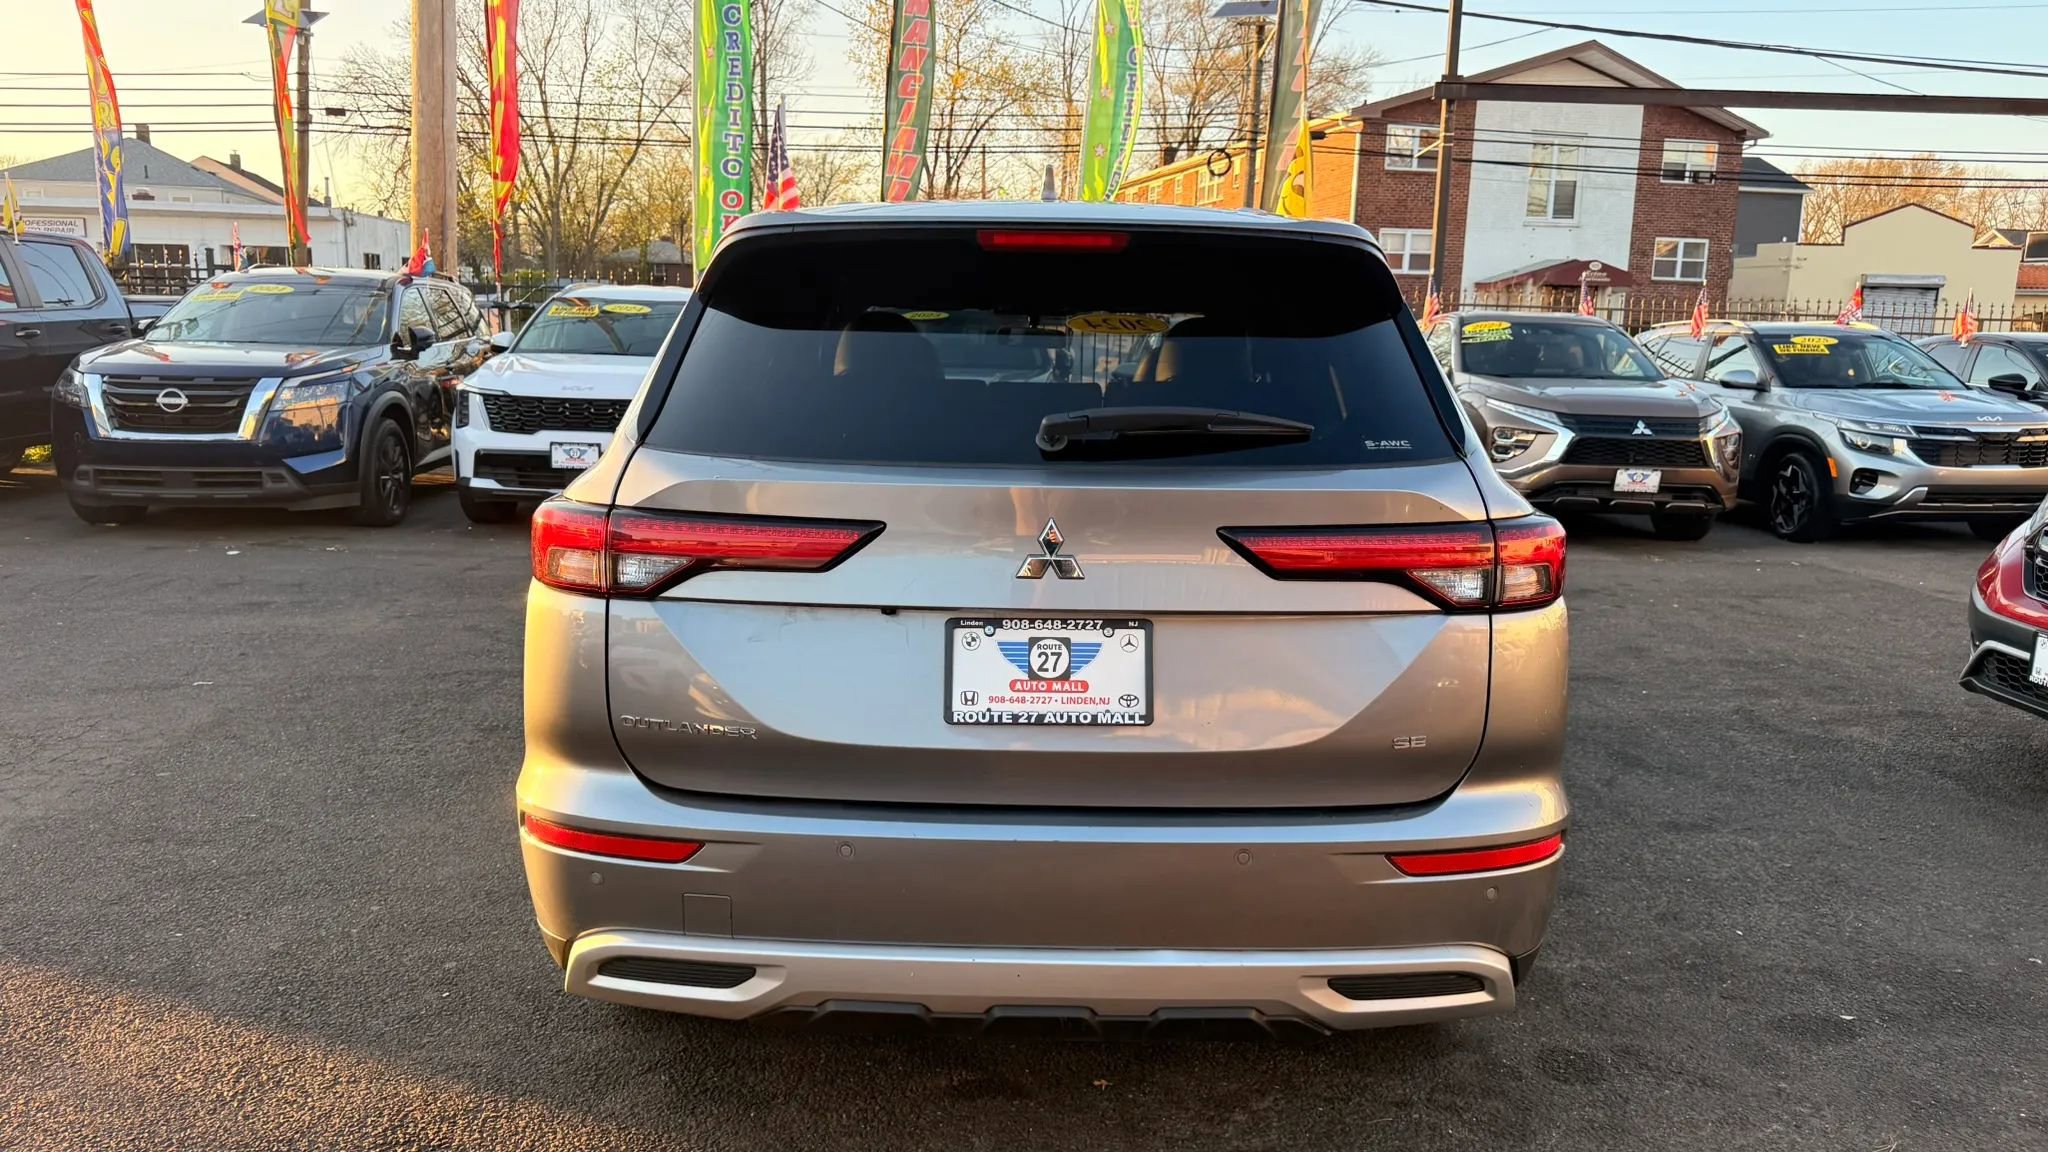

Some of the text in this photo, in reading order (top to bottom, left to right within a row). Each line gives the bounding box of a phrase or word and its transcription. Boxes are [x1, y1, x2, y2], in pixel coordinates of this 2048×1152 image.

[1002, 619, 1103, 631] 908-648-2727
[1036, 643, 1063, 651] ROUTE
[1036, 651, 1063, 673] 27
[1014, 681, 1085, 692] AUTO MALL
[988, 695, 1053, 705] 908-648-2727
[952, 711, 1146, 724] ROUTE 27 AUTO MALL
[620, 714, 758, 740] OUTLANDER
[1392, 735, 1427, 750] SE
